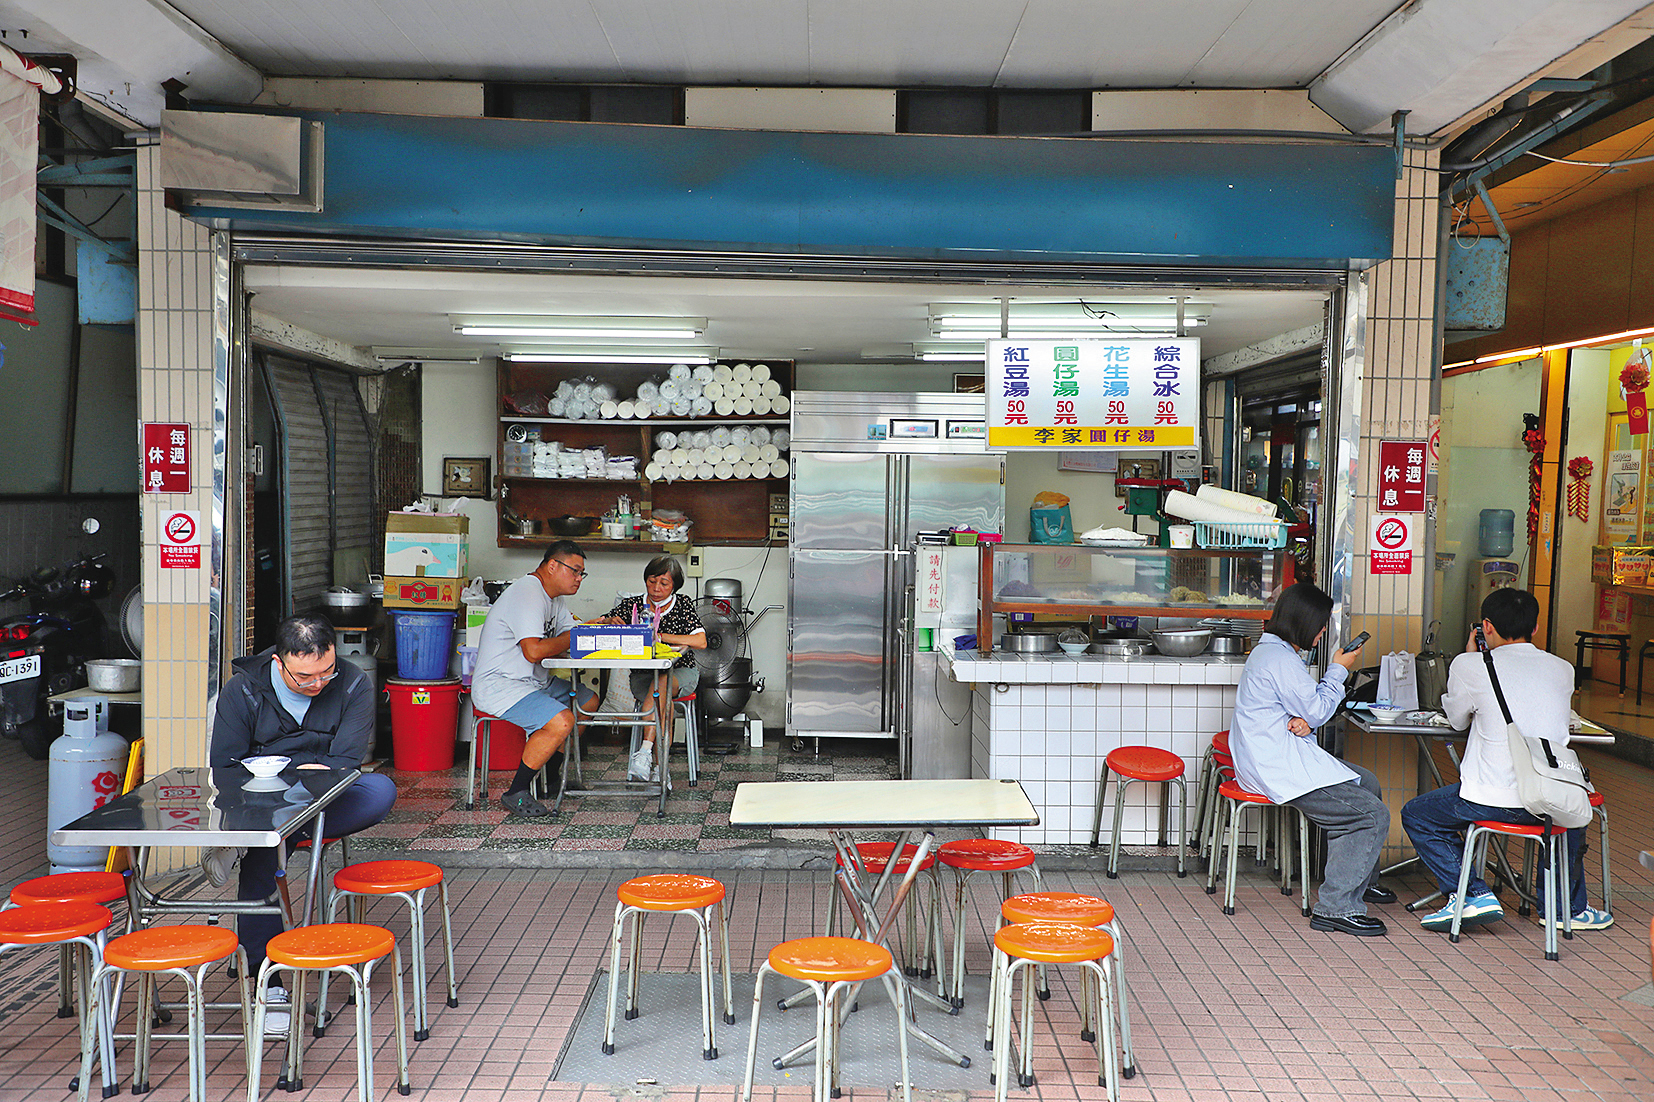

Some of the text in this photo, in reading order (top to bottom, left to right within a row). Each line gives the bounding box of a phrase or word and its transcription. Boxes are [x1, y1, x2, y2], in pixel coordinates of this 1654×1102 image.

[1003, 346, 1030, 397] 紅豆湯
[1053, 346, 1080, 397] 圓仔湯
[1103, 346, 1130, 397] 花生湯
[1152, 346, 1180, 397] 綜合冰
[170, 429, 187, 475] 每週一
[1034, 428, 1155, 444] 李家圓仔湯
[148, 446, 165, 487] 休息
[1382, 465, 1401, 506] 休息
[1404, 447, 1424, 494] 每週一
[928, 554, 941, 609] 請先付款
